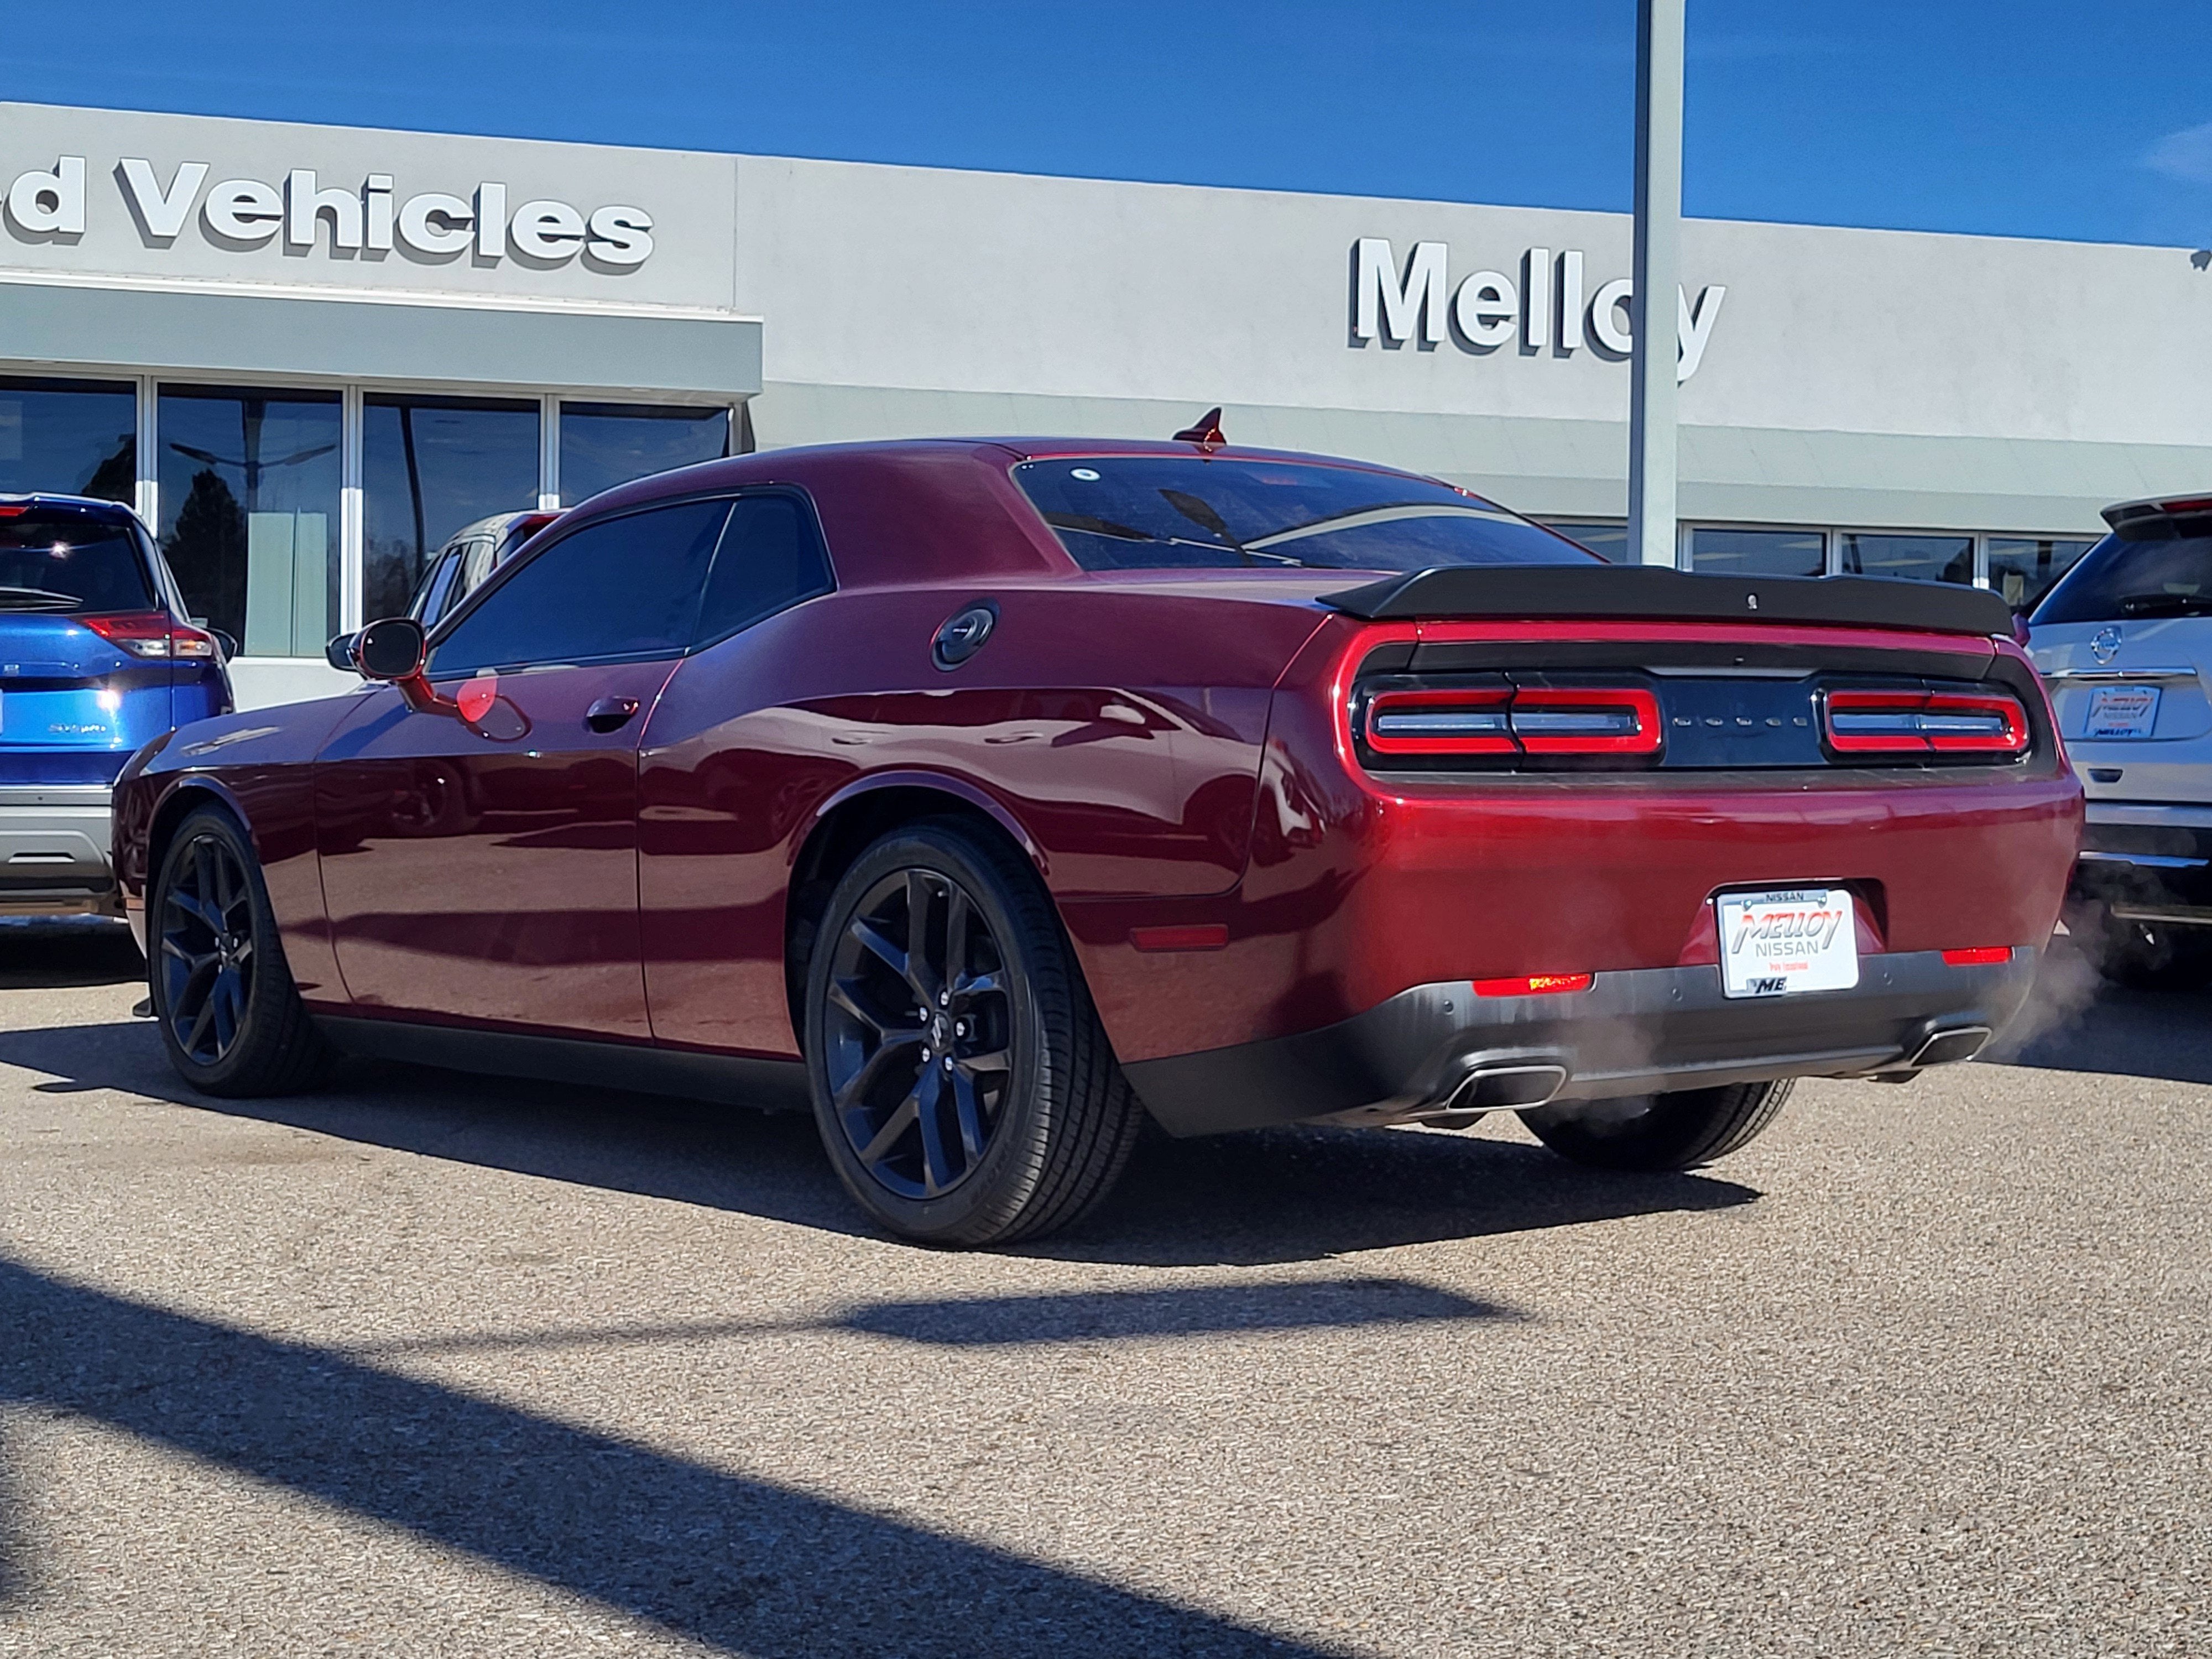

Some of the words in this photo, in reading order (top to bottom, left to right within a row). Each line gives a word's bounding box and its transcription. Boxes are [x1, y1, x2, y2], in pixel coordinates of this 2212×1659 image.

[0, 155, 86, 233] d
[115, 157, 655, 265] Vehicles
[1765, 892, 1804, 902] NISSAN
[1731, 910, 1843, 954] MELLOY
[1755, 941, 1819, 958] NISSAN
